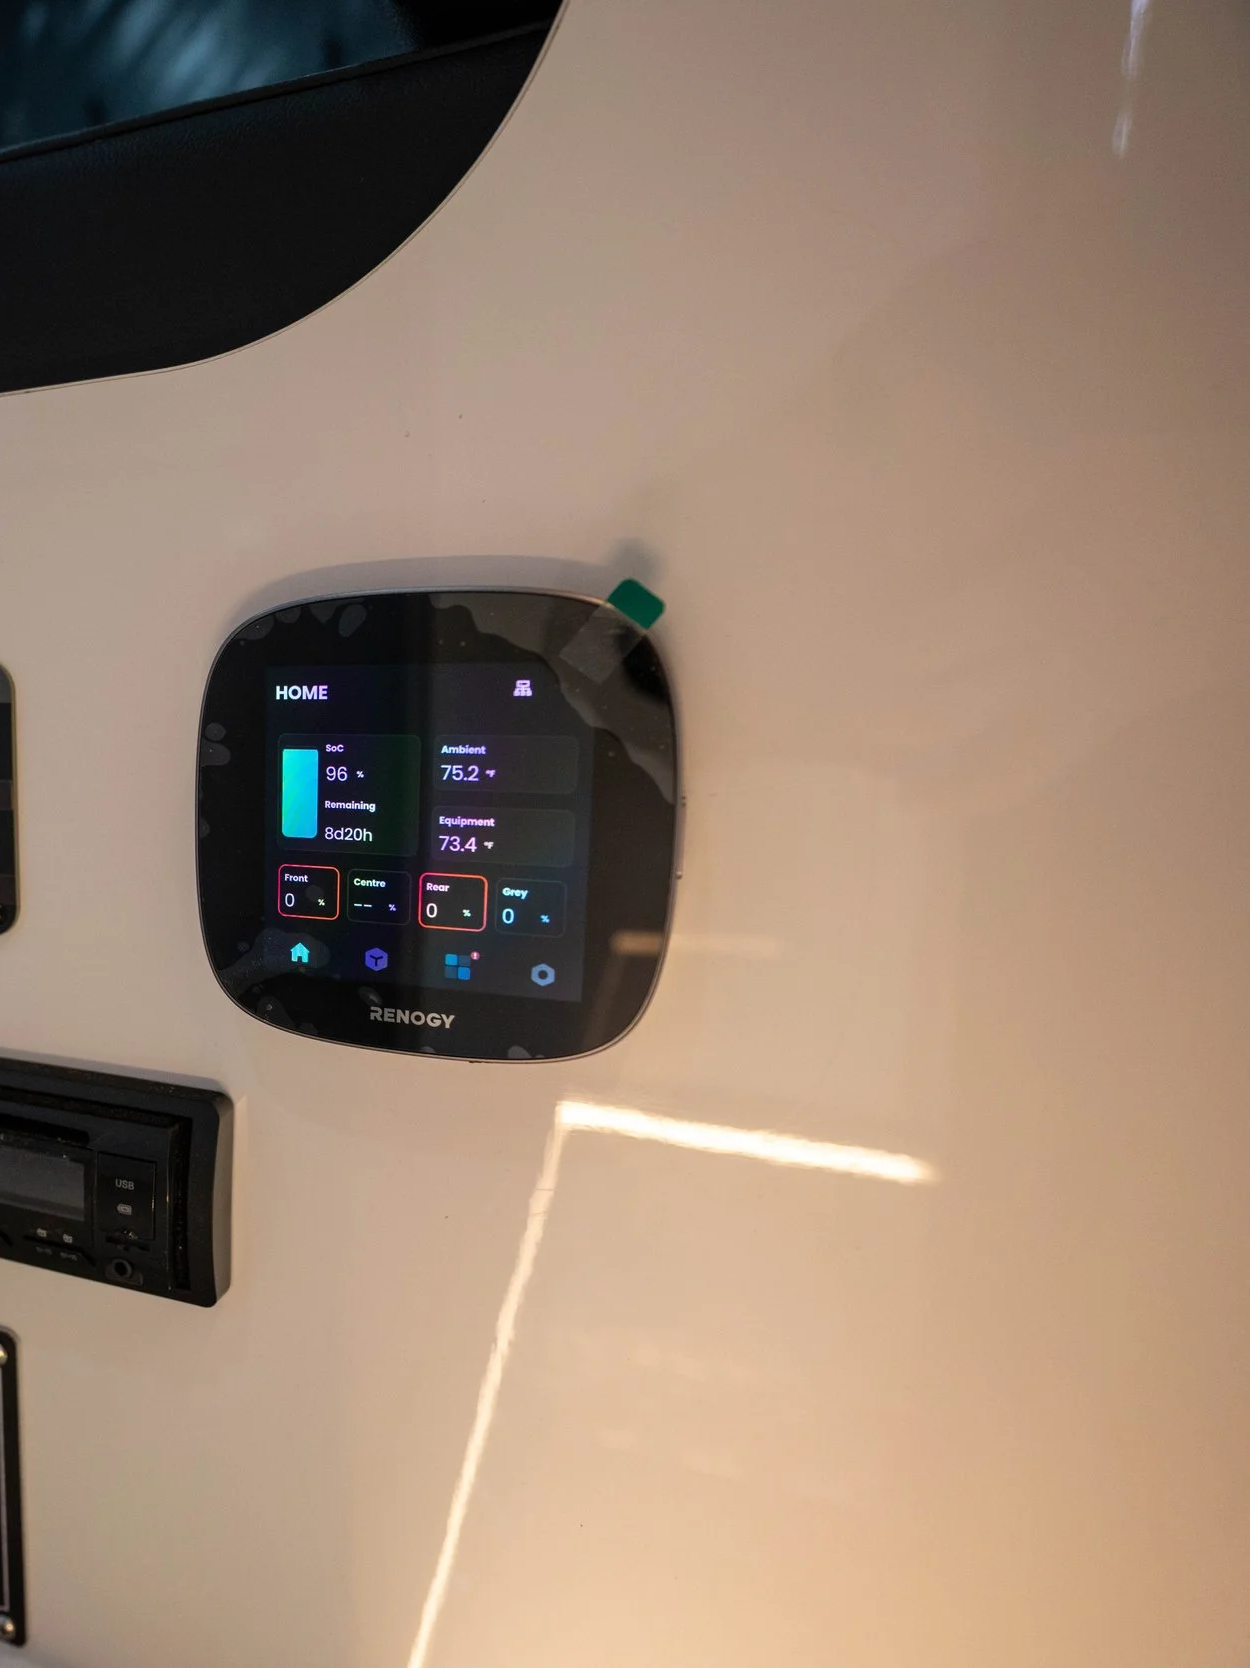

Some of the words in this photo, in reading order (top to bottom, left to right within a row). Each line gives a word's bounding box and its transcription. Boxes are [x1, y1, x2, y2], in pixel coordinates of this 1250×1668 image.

[275, 685, 329, 700] HOME
[325, 744, 344, 753] SoC
[441, 745, 486, 755] Ambient
[326, 766, 348, 782] 96
[440, 765, 480, 781] 75.2
[324, 801, 376, 812] Remaining
[439, 816, 495, 828] Equipment
[324, 827, 373, 842] 8d20h
[438, 835, 478, 852] 73.4
[284, 874, 308, 883] Front
[354, 878, 386, 888] Centre
[426, 882, 450, 892] Rear
[284, 893, 295, 907] 0
[318, 898, 326, 906] %
[502, 888, 528, 900] Grey
[388, 904, 396, 912] %
[426, 903, 438, 918] 0
[462, 909, 471, 917] %
[502, 908, 515, 924] 0
[370, 1006, 455, 1029] RENOGY
[115, 1178, 135, 1191] USB
